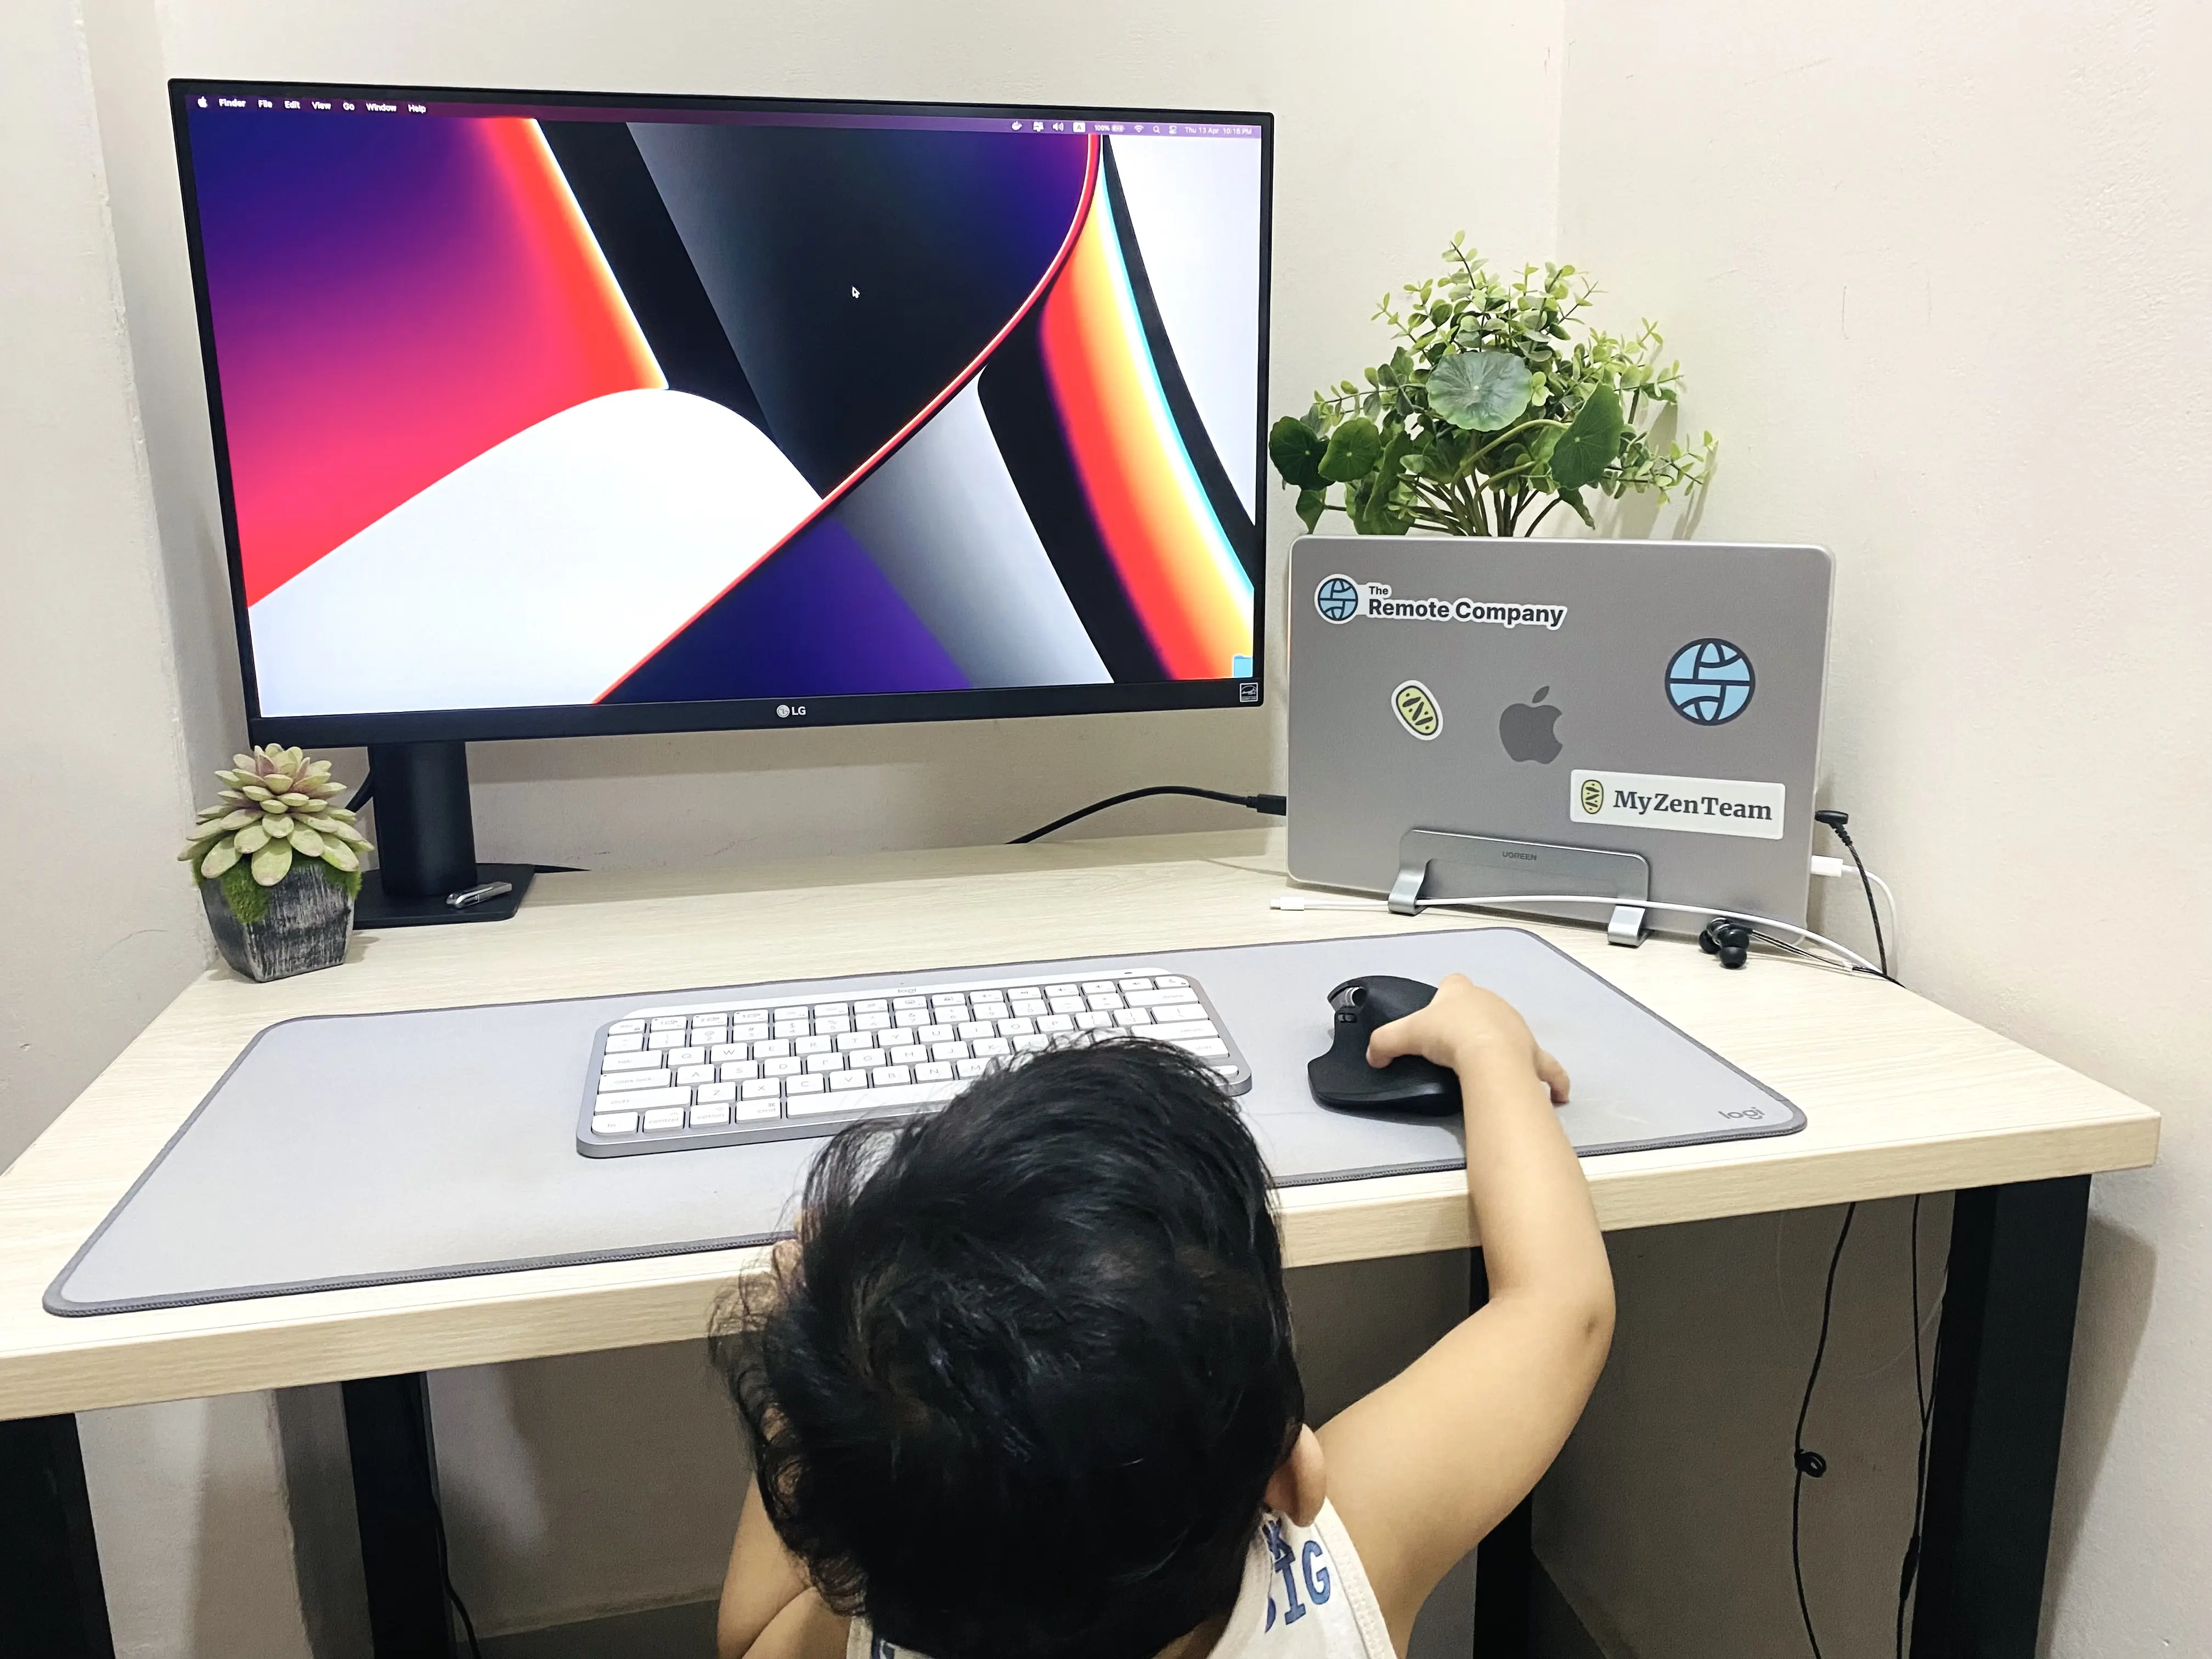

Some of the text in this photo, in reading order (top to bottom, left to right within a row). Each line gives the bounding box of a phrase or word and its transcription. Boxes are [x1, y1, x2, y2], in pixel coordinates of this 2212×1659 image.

[218, 98, 426, 114] Finder File Edit View Go Window Help
[1368, 585, 1389, 596] The
[1368, 598, 1564, 628] Remote Company
[791, 706, 806, 715] LG
[1613, 789, 1773, 821] MyZenTeam
[1502, 851, 1537, 861] UGREEN
[1718, 1107, 1765, 1120] logi
